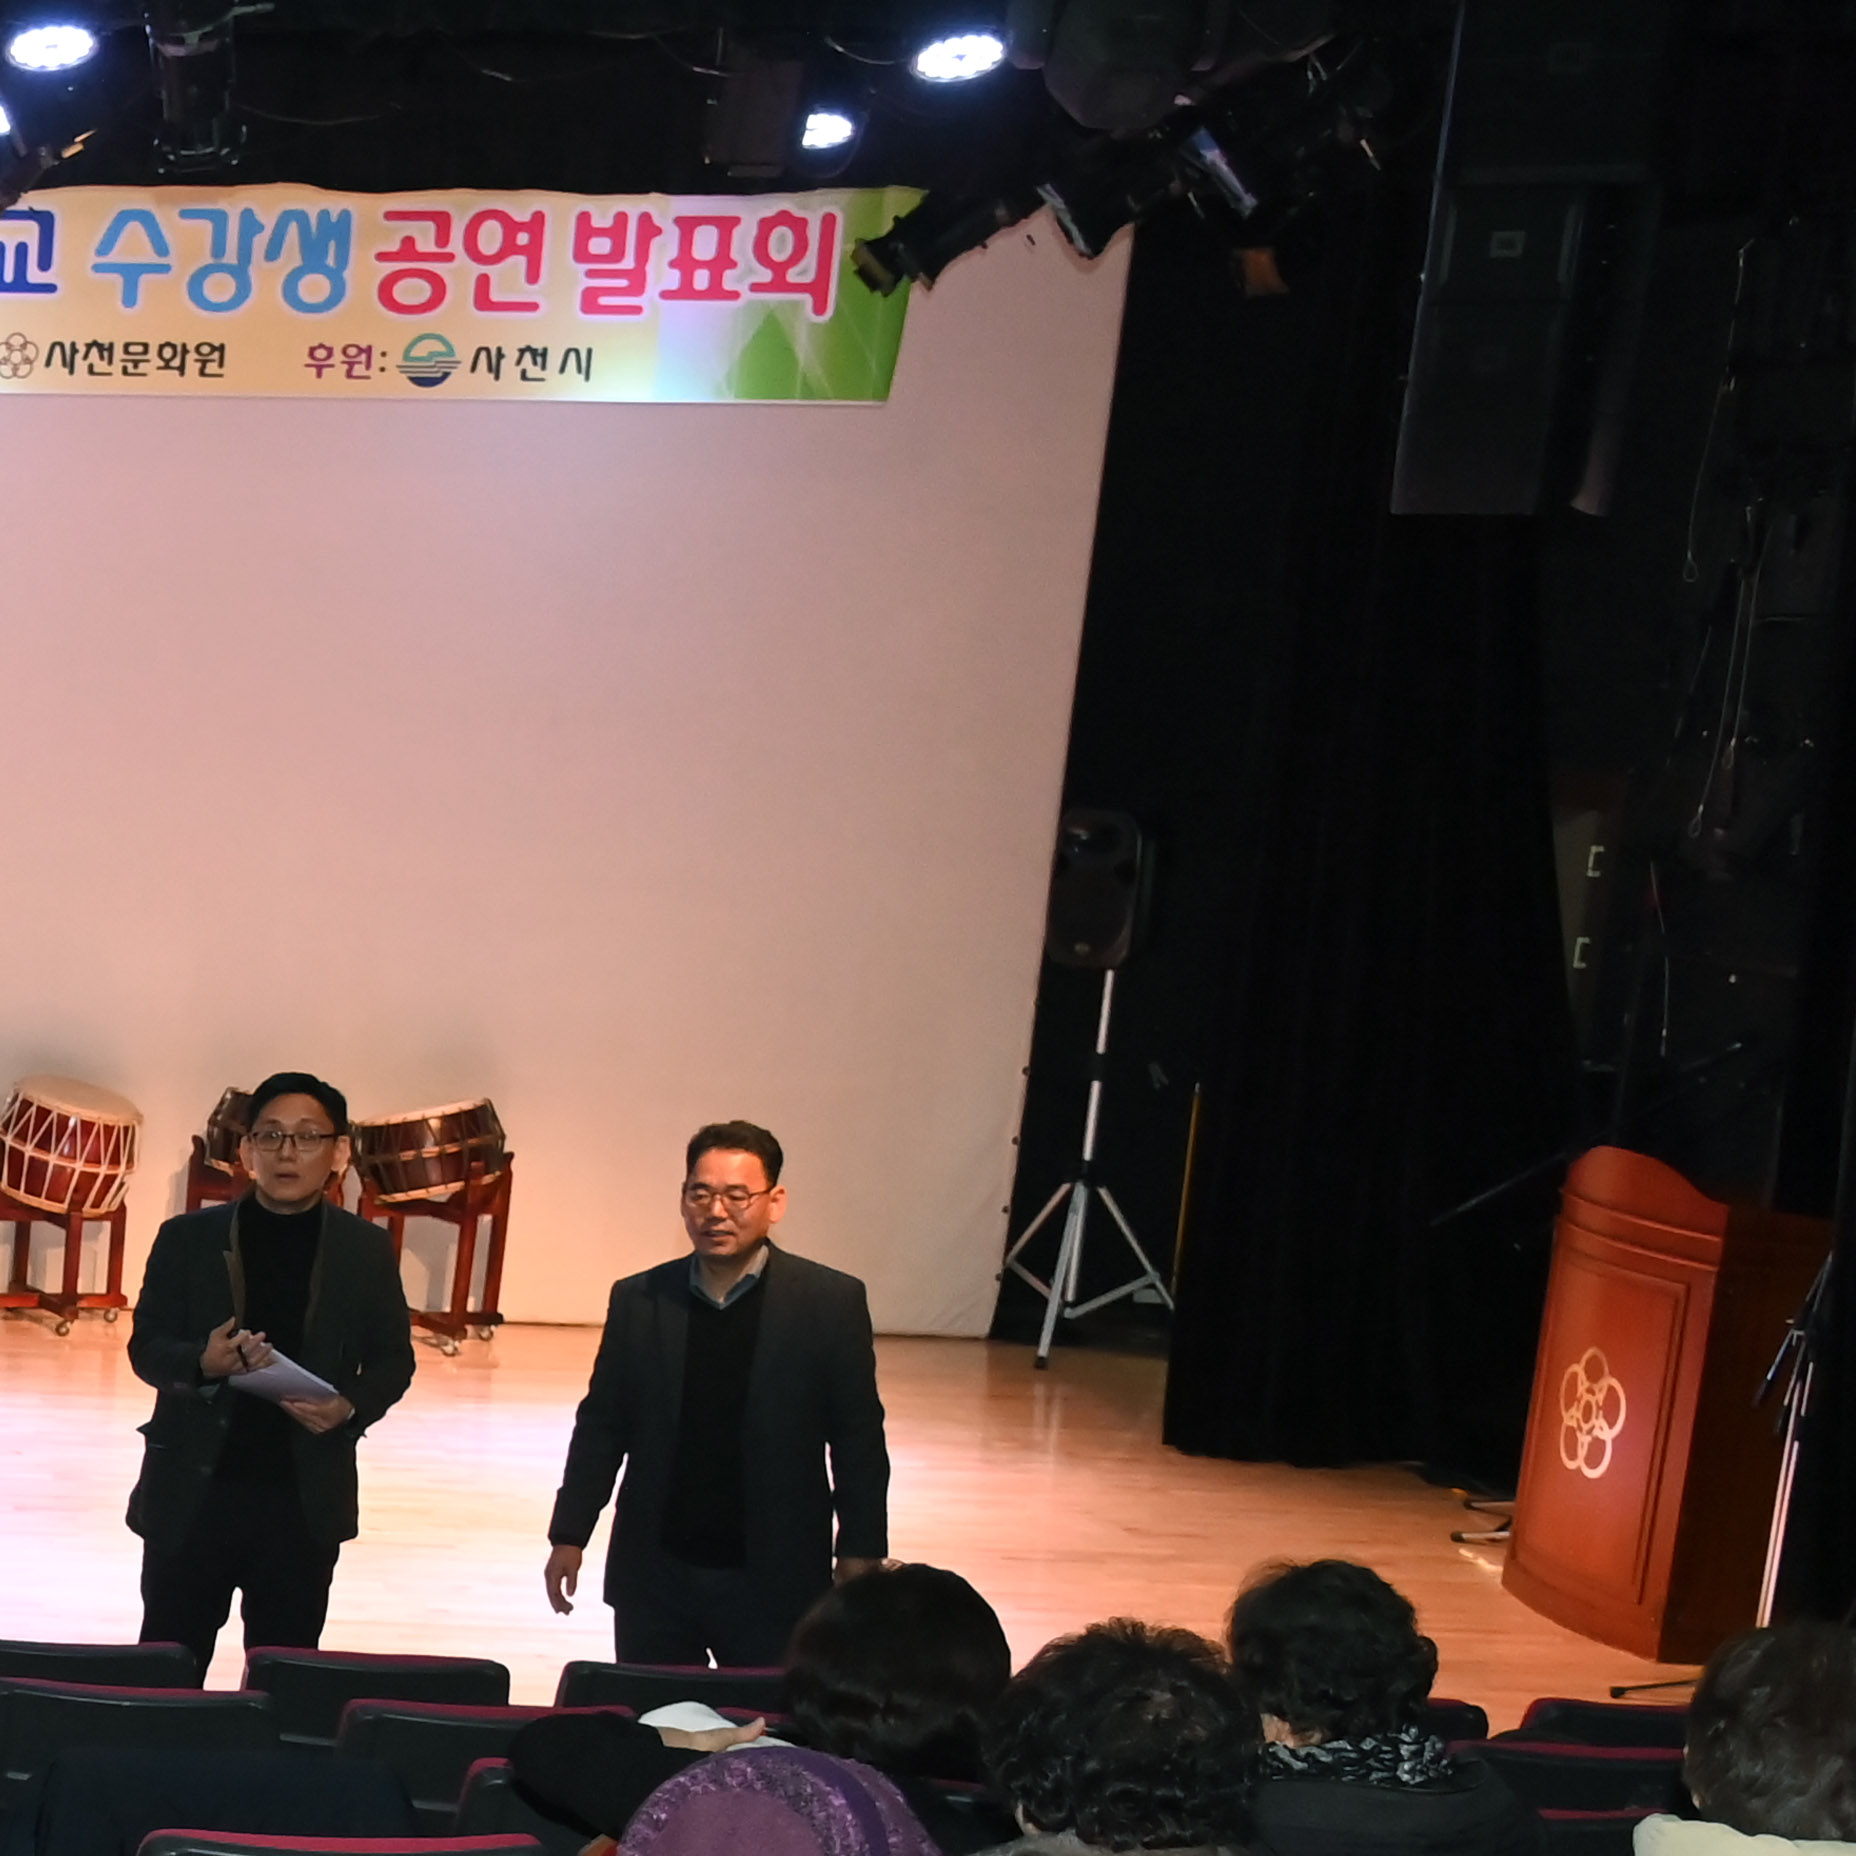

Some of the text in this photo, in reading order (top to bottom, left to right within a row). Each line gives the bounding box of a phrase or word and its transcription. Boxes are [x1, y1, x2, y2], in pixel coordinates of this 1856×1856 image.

[91, 206, 352, 316] 수강생
[374, 208, 544, 317] 공연
[574, 209, 840, 320] 발표회
[45, 339, 226, 380] 사천문화원
[304, 344, 594, 384] 후원: 사천시
